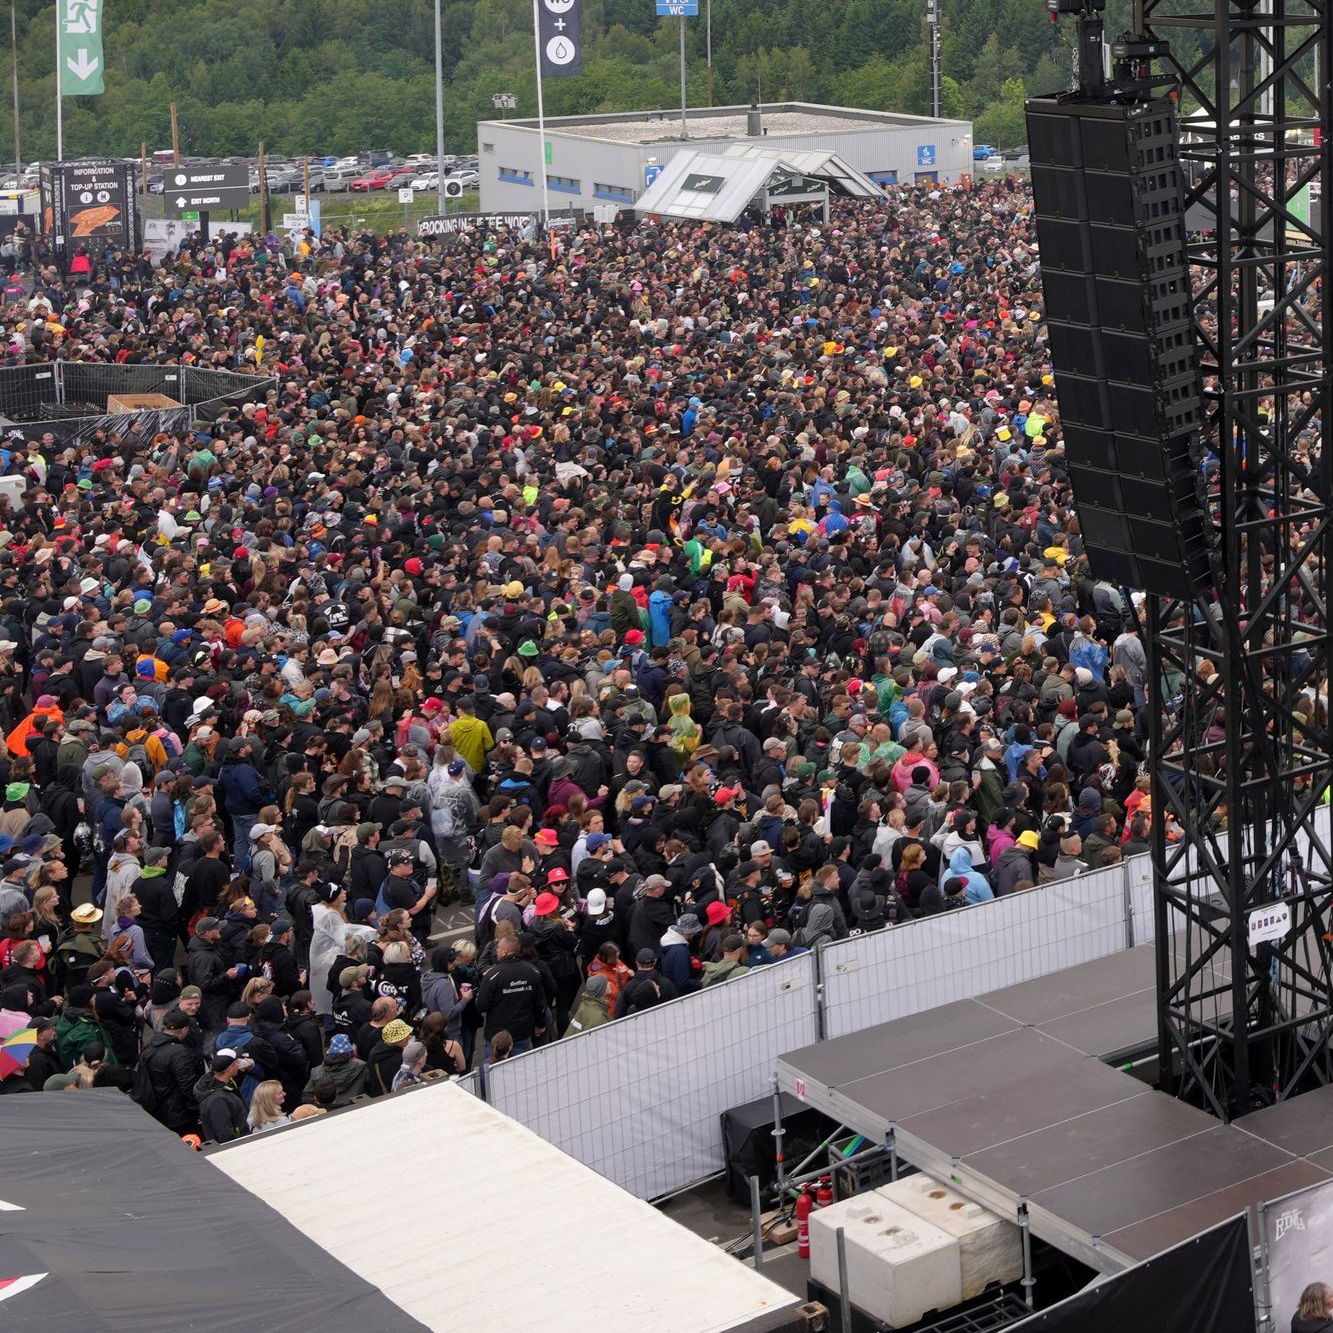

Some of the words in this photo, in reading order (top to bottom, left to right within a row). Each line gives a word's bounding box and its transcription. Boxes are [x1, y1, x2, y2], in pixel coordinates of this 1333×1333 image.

[669, 6, 685, 15] WC
[74, 167, 114, 175] INFORMATION
[214, 174, 225, 182] EXIT
[95, 182, 118, 190] STATION
[450, 183, 456, 194] 9
